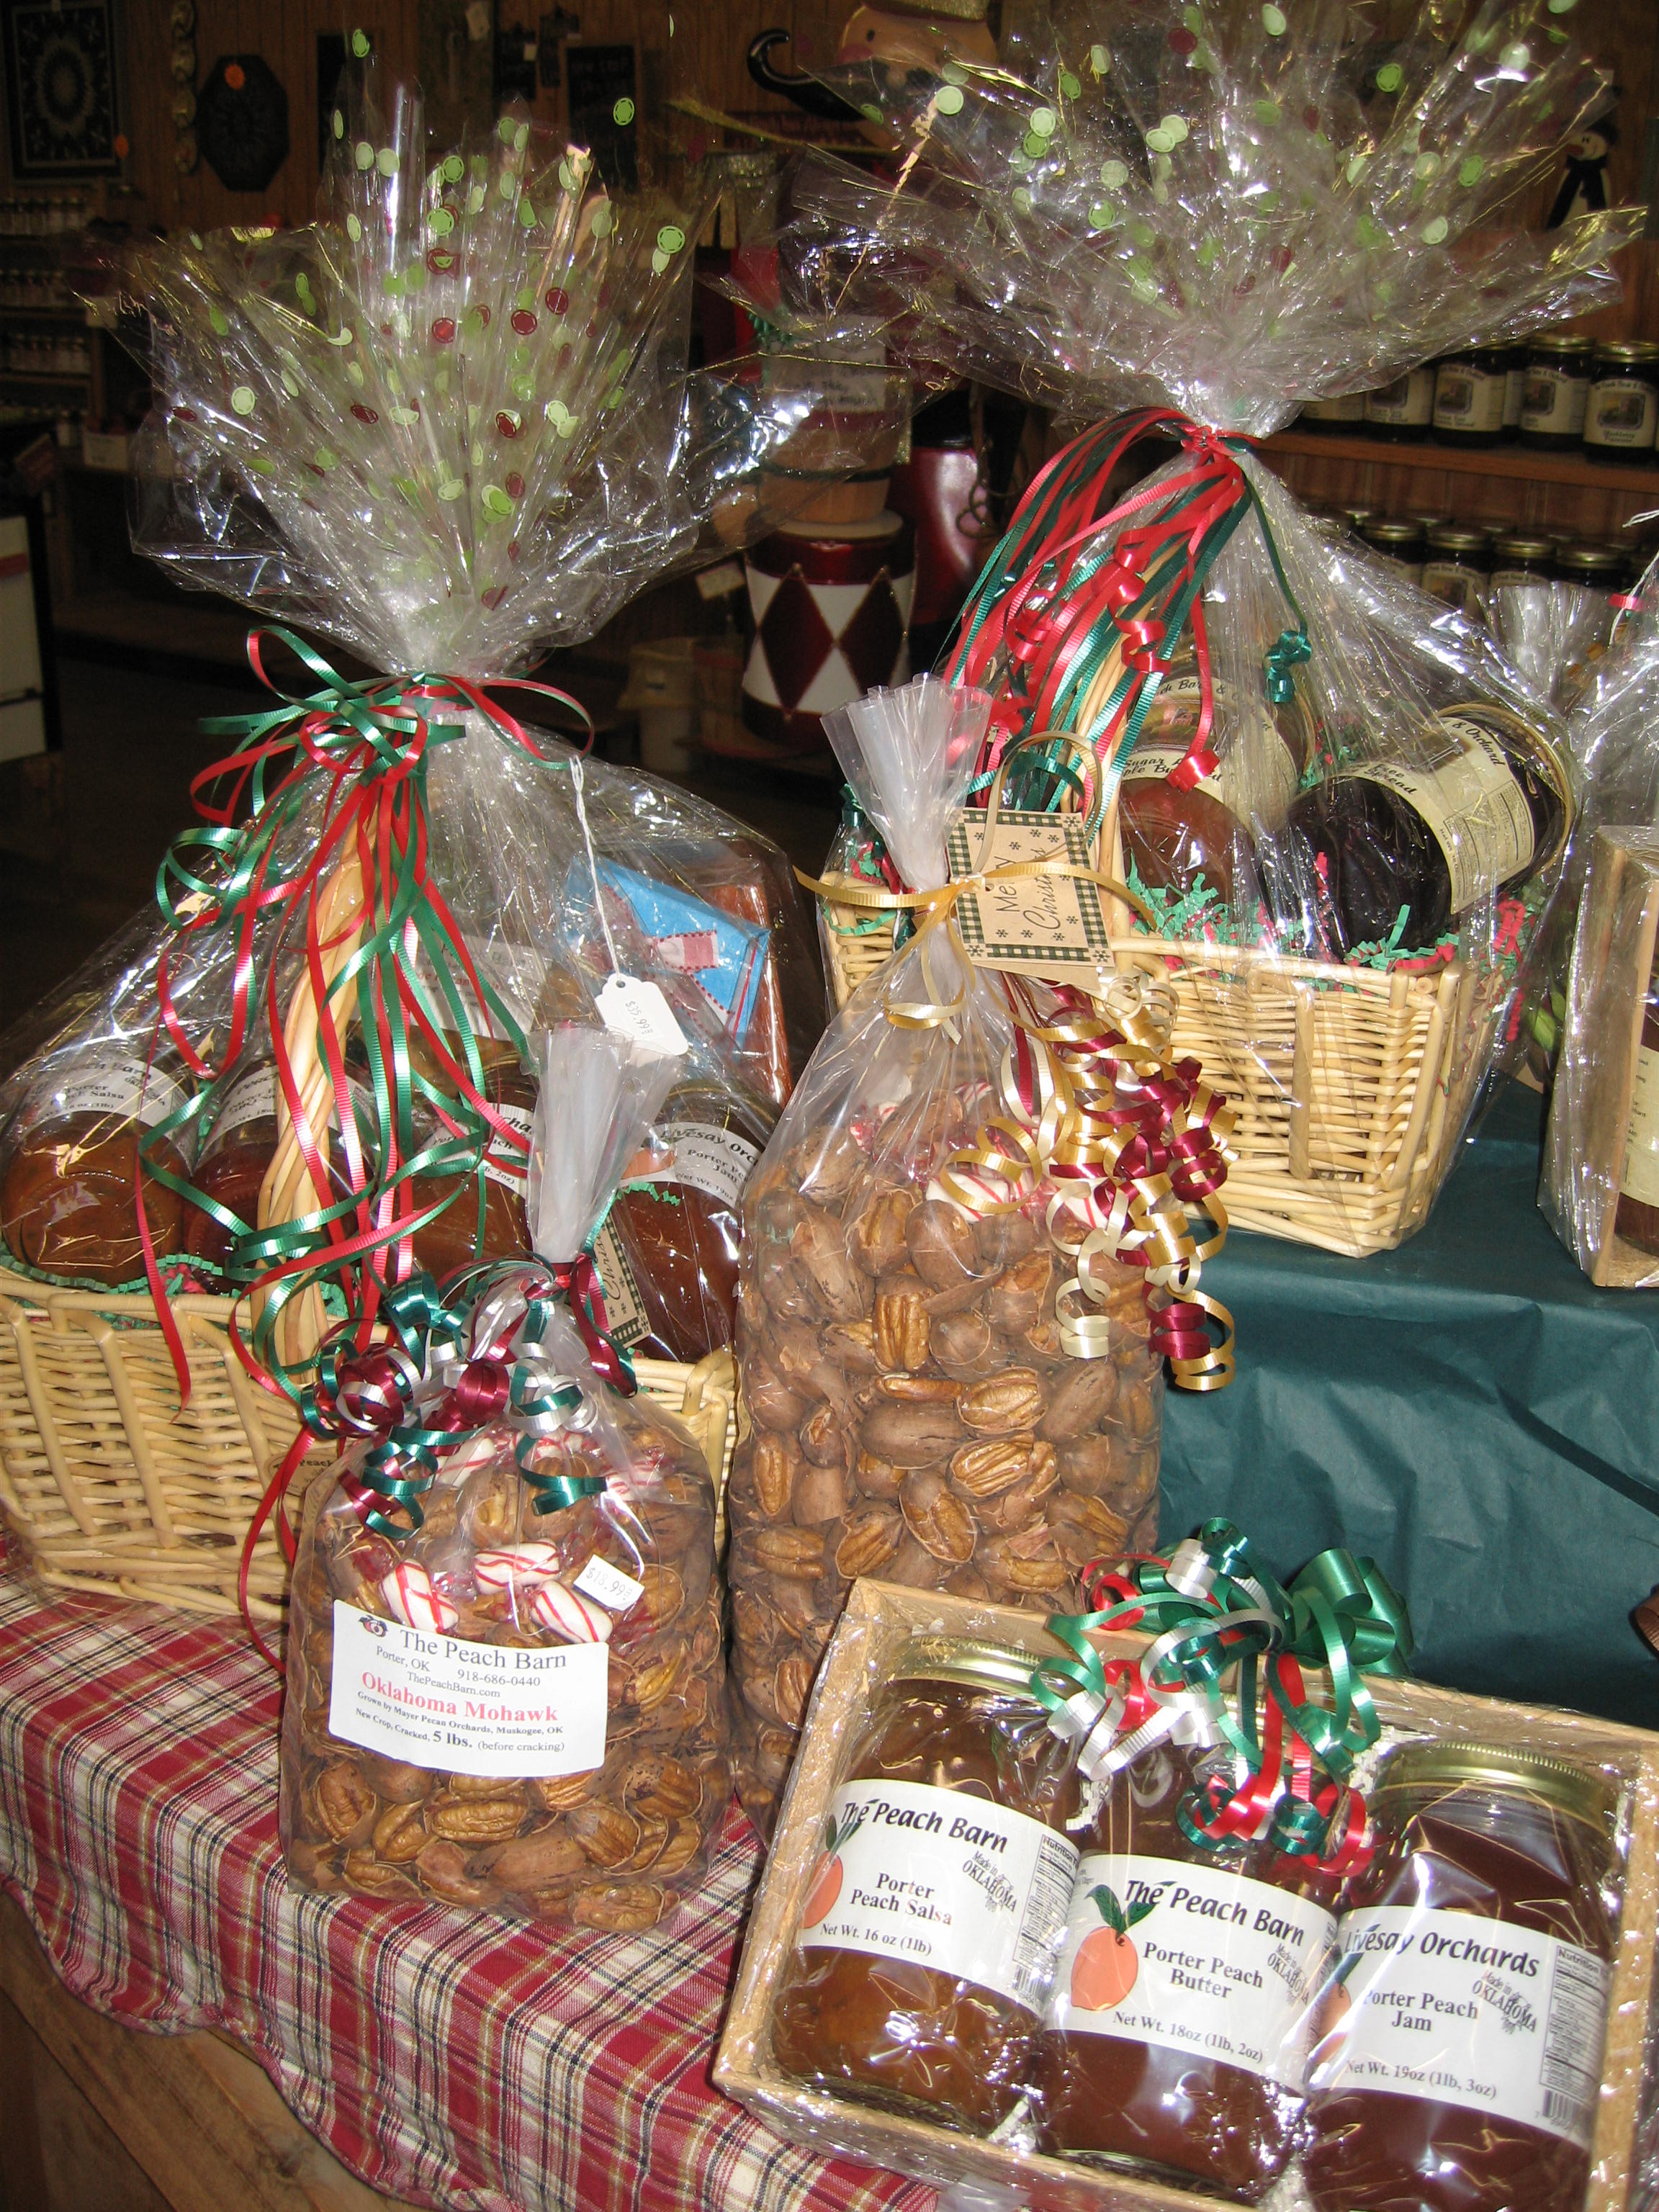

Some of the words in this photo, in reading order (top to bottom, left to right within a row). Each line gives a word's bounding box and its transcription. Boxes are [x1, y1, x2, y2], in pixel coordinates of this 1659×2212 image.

[1465, 727, 1506, 766] Orchard
[994, 855, 1020, 912] Mey
[89, 1091, 125, 1100] Salsa
[688, 1148, 728, 1167] Porter
[712, 1165, 737, 1184] Jam
[376, 1645, 409, 1668] Porter,
[410, 1658, 431, 1672] OK
[457, 1668, 541, 1687] 918-686-0440
[400, 1629, 439, 1655] The
[444, 1640, 507, 1668] Peach
[514, 1652, 567, 1670] Barn
[362, 1671, 457, 1715] Oklahoma
[464, 1700, 559, 1722] Mohawk
[407, 1671, 501, 1699] ThePeachBarn.com
[356, 1707, 372, 1720] New
[373, 1714, 394, 1731] Crop,
[395, 1724, 431, 1743] Cracked,
[432, 1730, 442, 1743] 5
[446, 1732, 473, 1748] lbs.
[477, 1740, 514, 1752] (before
[516, 1741, 566, 1753] cracking)
[357, 1691, 382, 1707] Grown
[383, 1701, 393, 1713] by
[394, 1705, 420, 1722] Mayer
[421, 1714, 447, 1727] Pecan
[449, 1719, 494, 1735] Orchards,
[496, 1726, 545, 1737] Muskogee,
[841, 1802, 870, 1825] The
[873, 1802, 943, 1833] Peach
[948, 1817, 1008, 1854] Barn
[972, 1851, 992, 1869] Made
[989, 1865, 998, 1876] in
[876, 1871, 935, 1899] Porter
[962, 1860, 1018, 1913] OKLAHOMA
[850, 1888, 899, 1912] Peach
[904, 1898, 953, 1926] Salsa
[1124, 1879, 1164, 1905] The
[1169, 1887, 1248, 1926] Peach
[1253, 1909, 1305, 1947] Barn
[820, 1922, 838, 1936] Net
[841, 1923, 860, 1938] Wt.
[864, 1927, 879, 1942] 16
[881, 1933, 896, 1946] oz
[900, 1936, 932, 1956] (1lb)
[1344, 1928, 1415, 1956] Livesay
[1420, 1932, 1540, 1978] Orchards
[1142, 1941, 1205, 1970] Porter
[1210, 1956, 1264, 1989] Peach
[1557, 1947, 1600, 1973] Nutrition
[1169, 1967, 1233, 2000] Butter
[1391, 2010, 1432, 2033] Jam
[1420, 1992, 1480, 2020] Peach
[1473, 1979, 1539, 2033] OKLAHOMA
[1112, 2011, 1137, 2027] Net
[1141, 2015, 1164, 2034] Wt.
[1168, 2022, 1203, 2044] 18oz
[1205, 2031, 1235, 2054] (1lb,
[1238, 2042, 1264, 2064] 2oz)
[1345, 2059, 1364, 2074] Net
[1367, 2060, 1389, 2077] Wt.
[1393, 2064, 1426, 2083] 19oz
[1429, 2070, 1462, 2092] (1lb,
[1467, 2077, 1498, 2101] 3oz)
